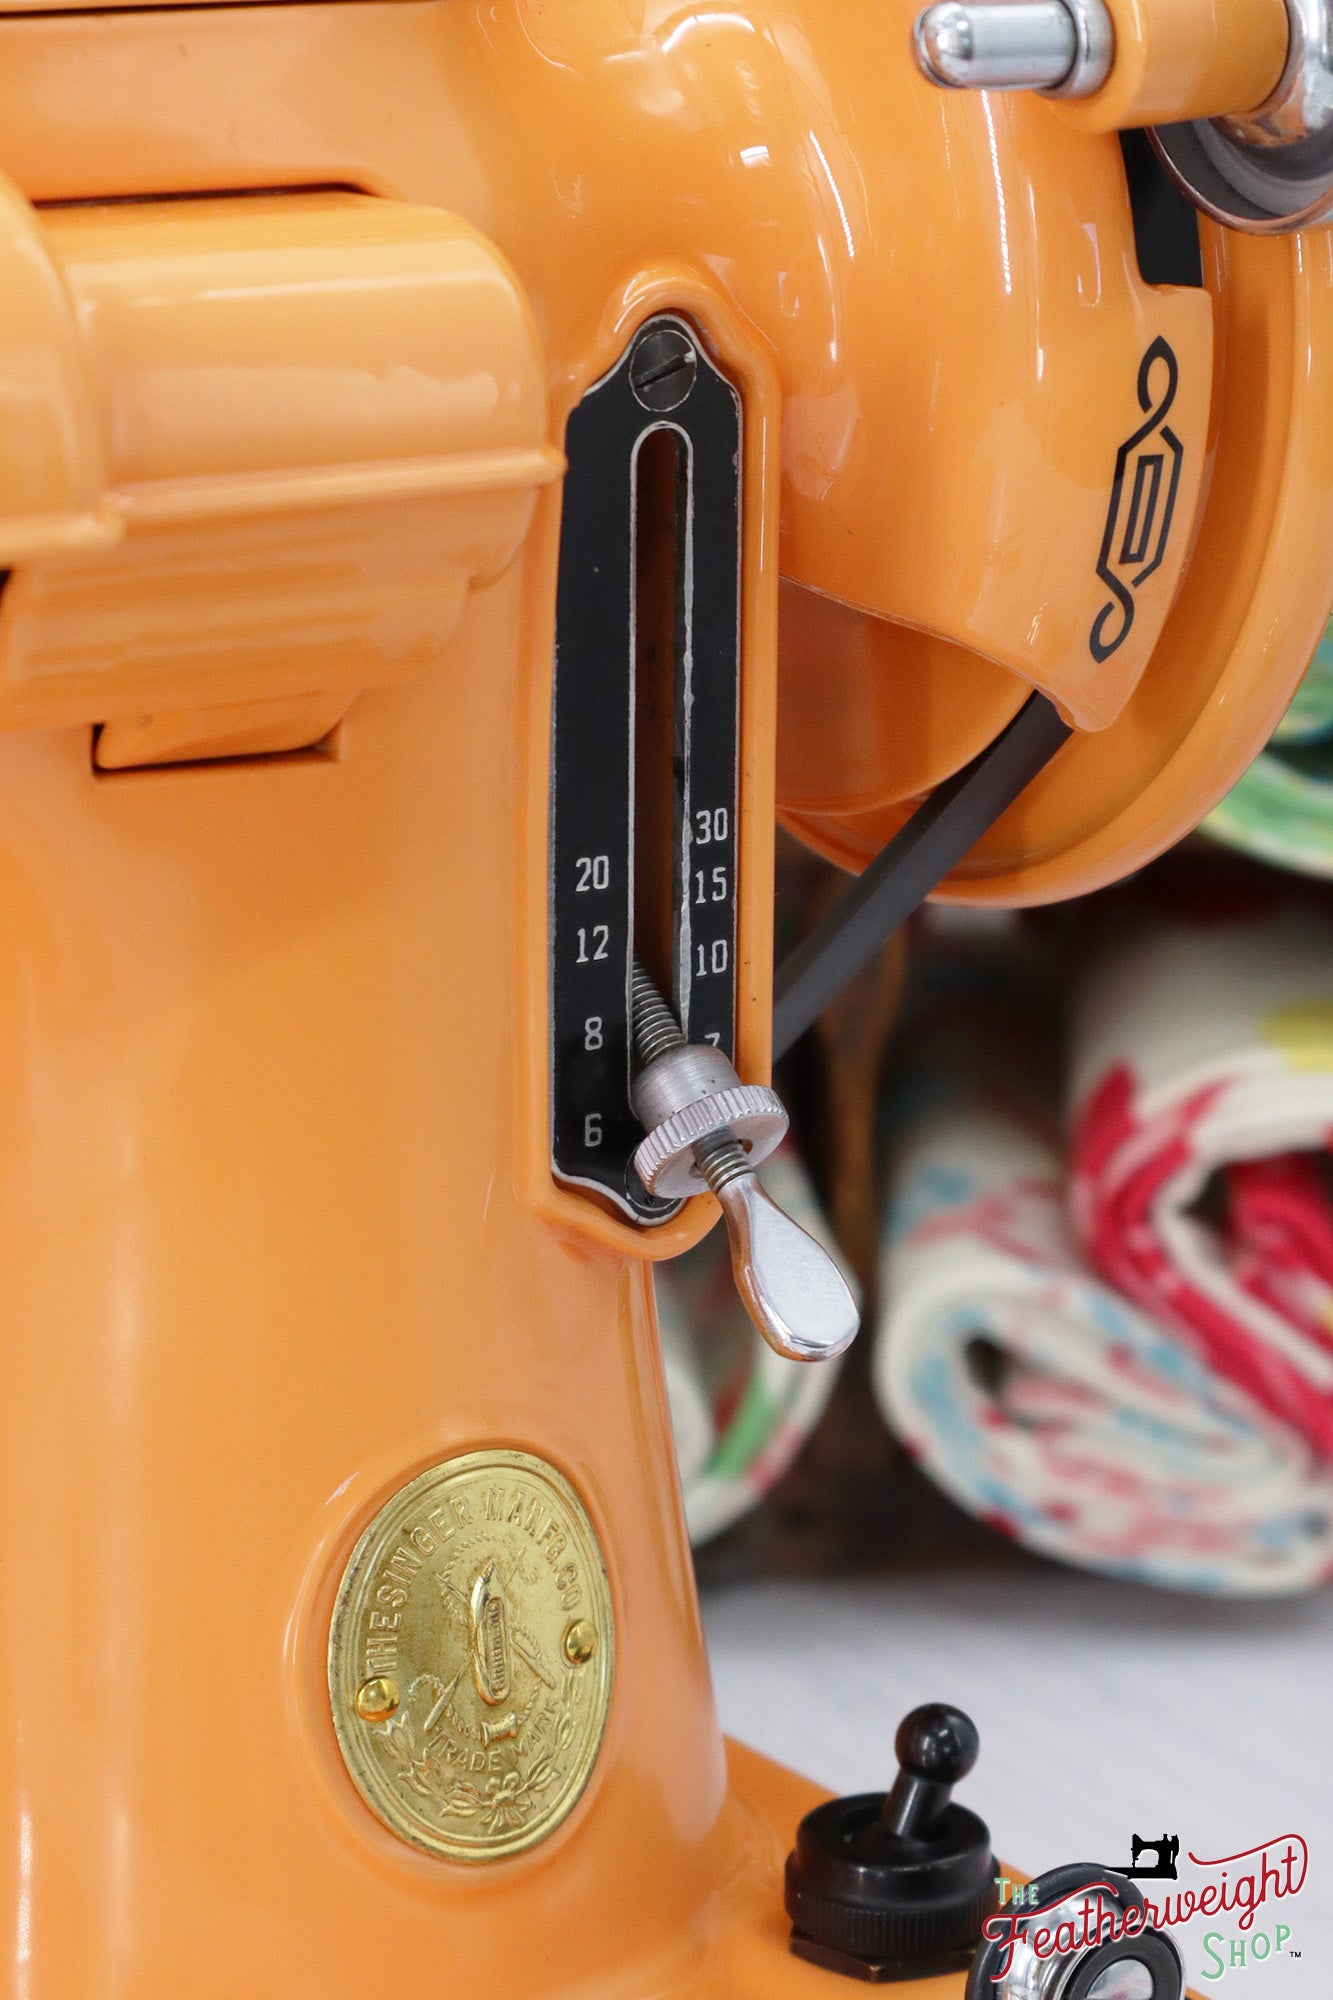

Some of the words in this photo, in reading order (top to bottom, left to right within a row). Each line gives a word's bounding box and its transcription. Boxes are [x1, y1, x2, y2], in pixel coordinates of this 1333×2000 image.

[695, 808, 728, 844] 30
[575, 855, 609, 892] 20
[695, 866, 728, 904] 15
[575, 925, 609, 963] 12
[695, 939, 728, 977] 10
[584, 1016, 604, 1051] 8
[584, 1113, 603, 1147] 6
[376, 1495, 474, 1609] SINGER
[366, 1611, 402, 1677] THE
[427, 1728, 502, 1772] TRADE
[511, 1696, 560, 1758] MARK
